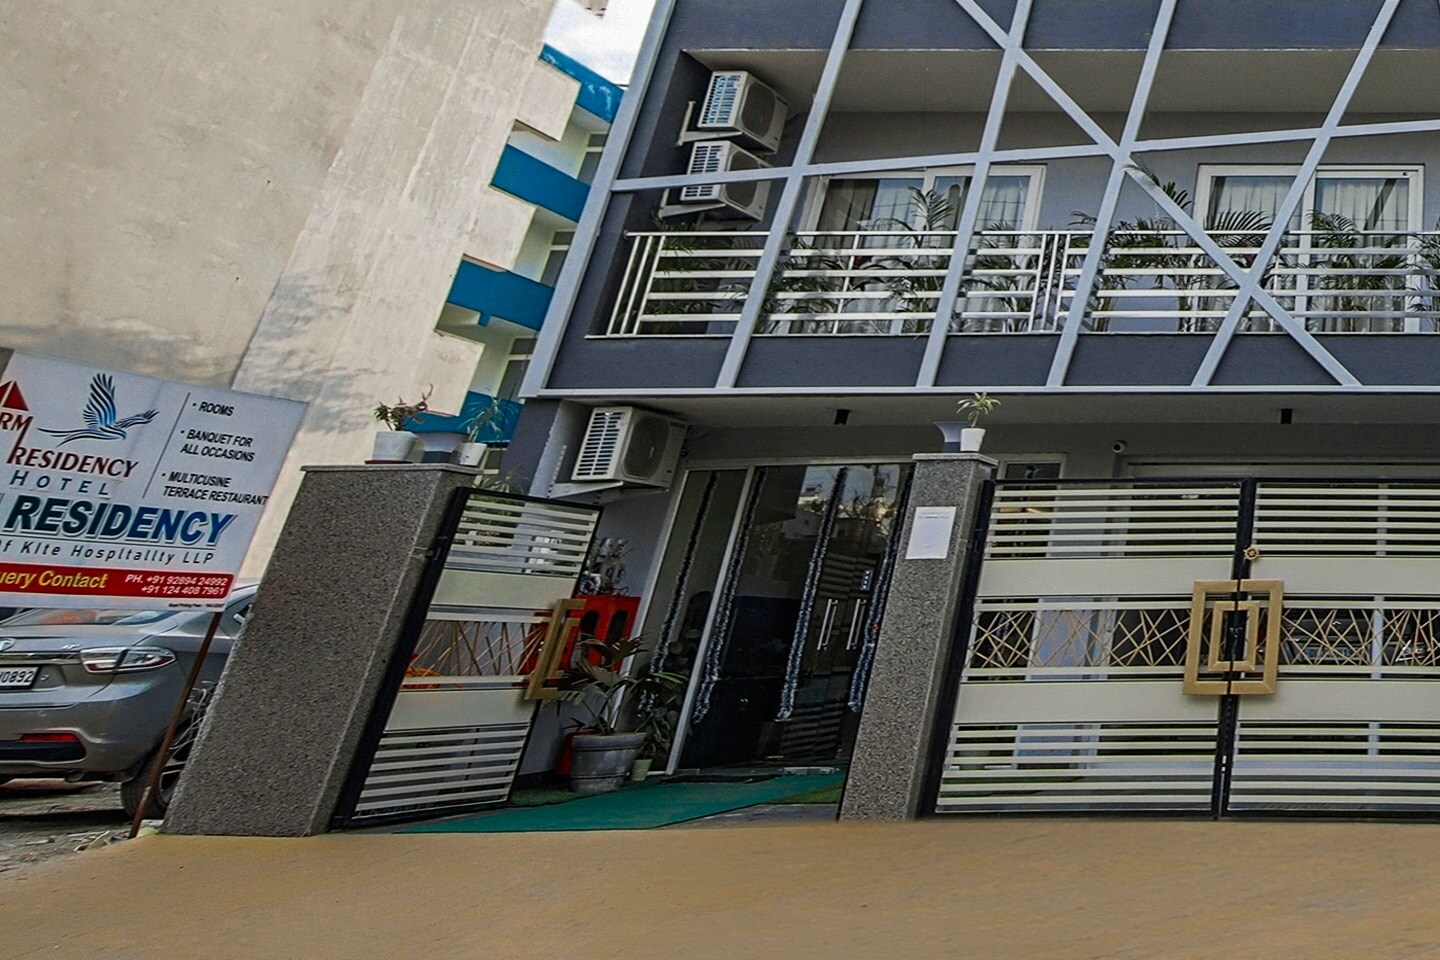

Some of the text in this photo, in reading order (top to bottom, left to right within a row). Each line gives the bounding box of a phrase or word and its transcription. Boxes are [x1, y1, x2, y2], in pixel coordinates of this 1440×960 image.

[198, 401, 235, 416] ROOMS
[186, 429, 254, 448] BANQUET FOR
[6, 446, 139, 478] RESIDENCY
[180, 443, 256, 462] ALL OCCASIONS
[9, 469, 110, 496] HOTEL
[168, 471, 232, 488] MULTICUSINE
[163, 485, 269, 506] TERRACE RESTAURANT
[3, 494, 237, 546] RESIDENCY
[182, 551, 214, 564] LLP
[38, 569, 108, 588] Contact
[125, 574, 228, 586] PH. +91 92894 24992
[141, 585, 160, 594] +91
[162, 586, 181, 595] 124
[0, 671, 34, 683] 0892
